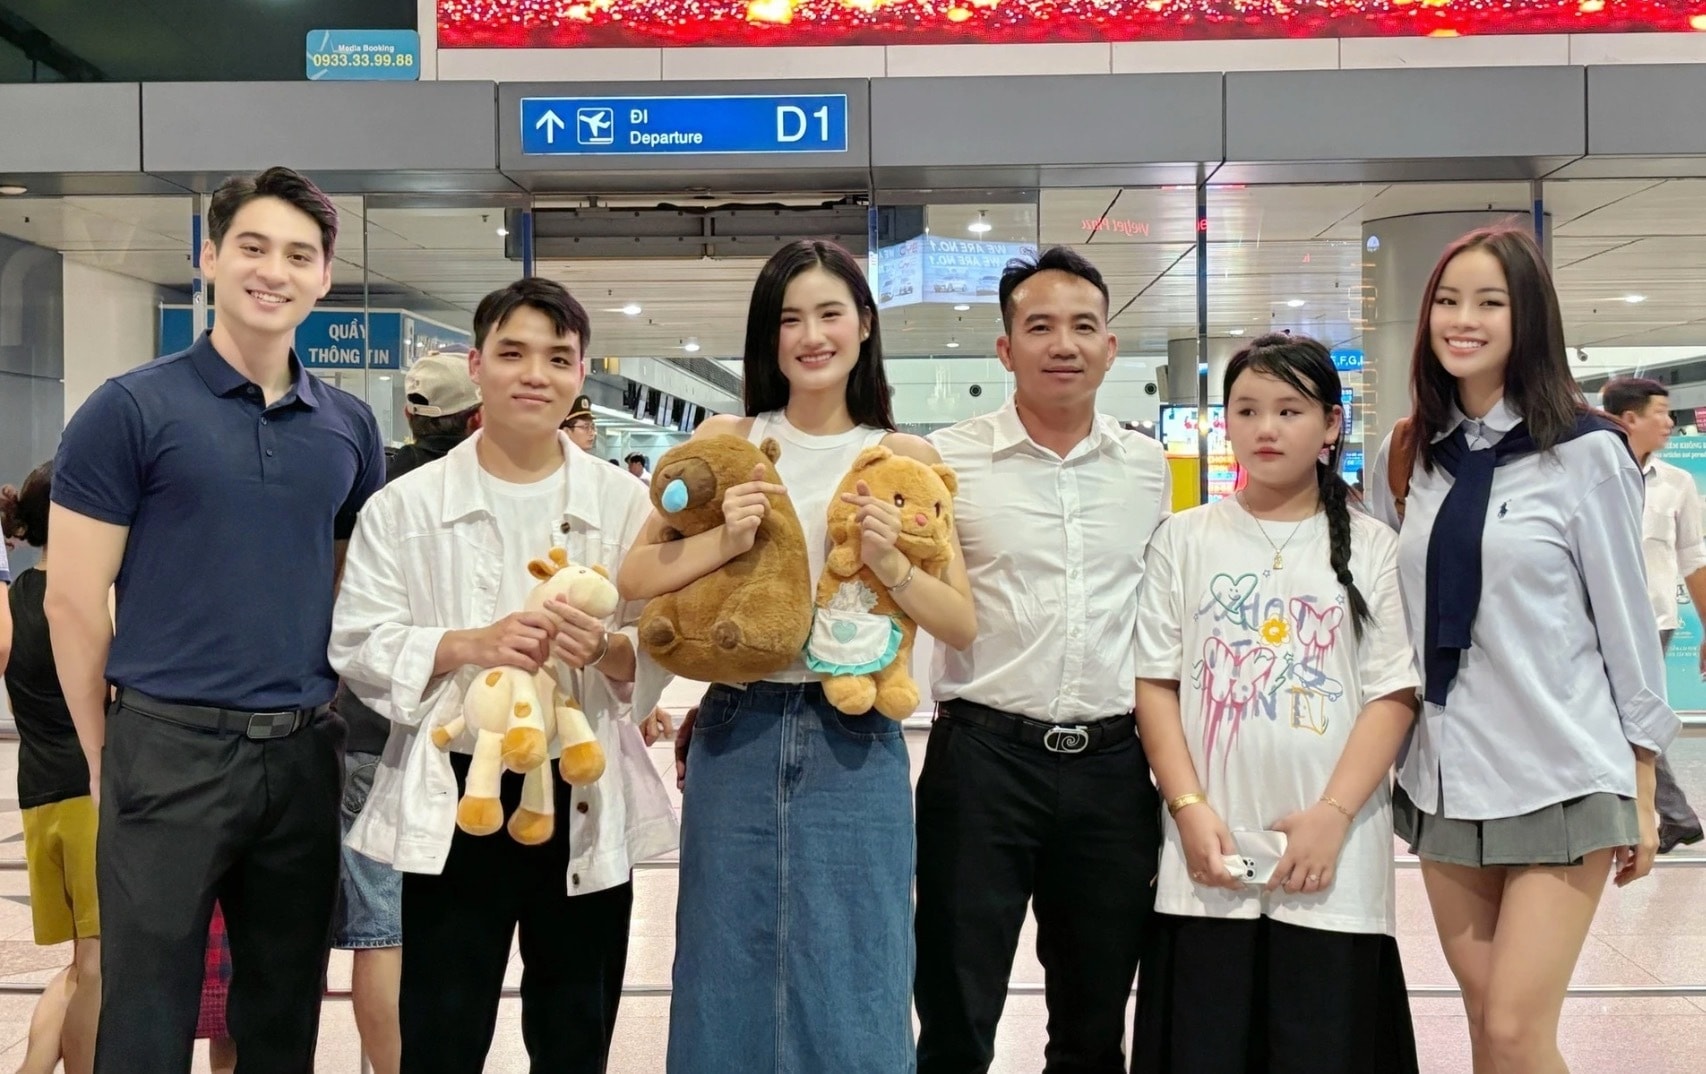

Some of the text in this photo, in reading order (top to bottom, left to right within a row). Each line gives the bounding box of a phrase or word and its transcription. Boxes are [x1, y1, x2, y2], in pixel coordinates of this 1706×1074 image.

[338, 44, 395, 53] Media Booking
[313, 54, 413, 67] 0933.33.99.88
[630, 109, 648, 124] ĐI
[776, 105, 829, 142] D1
[630, 131, 703, 147] Departure
[308, 345, 390, 365] THÔNG TIN
